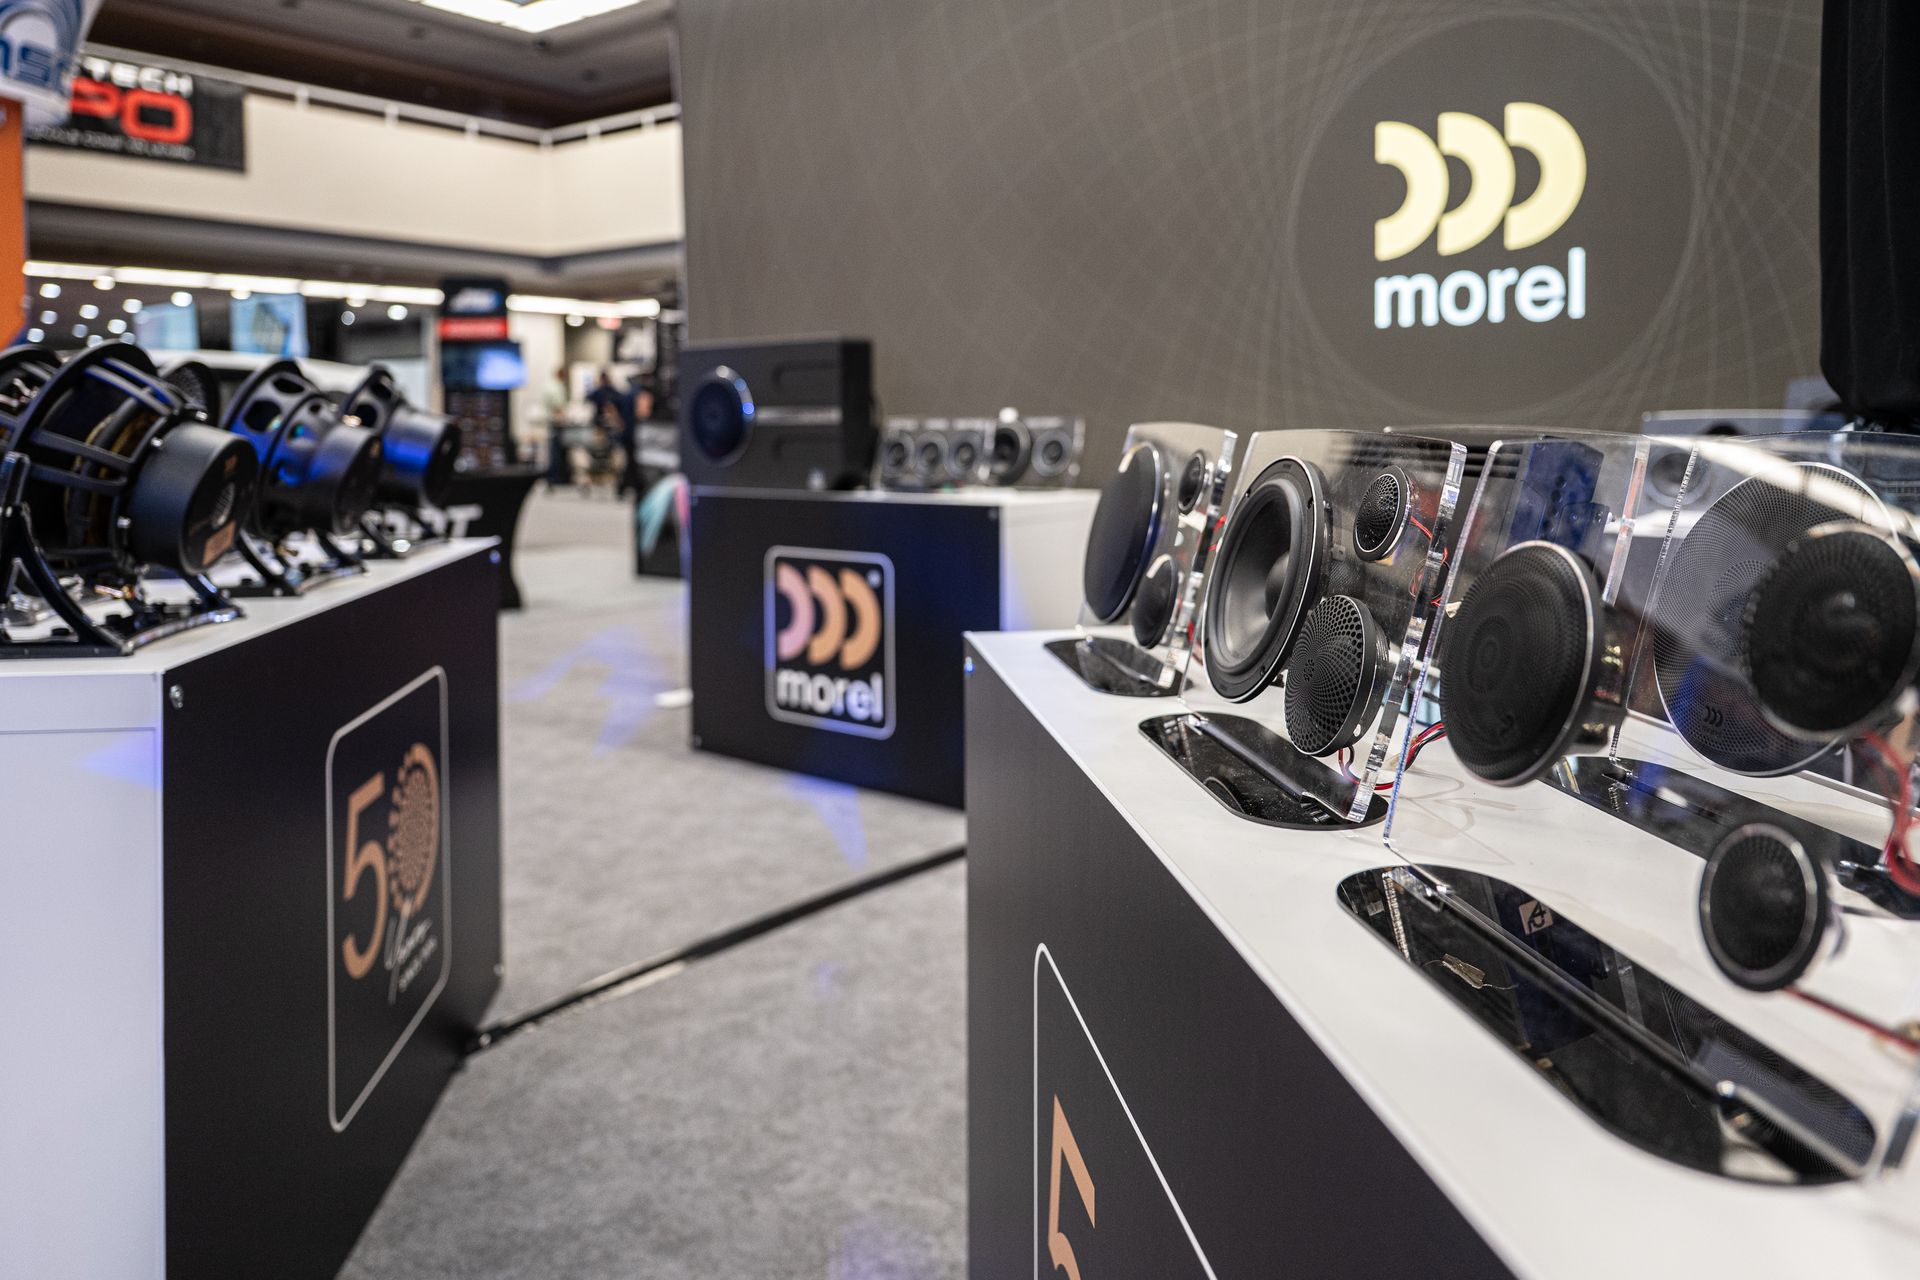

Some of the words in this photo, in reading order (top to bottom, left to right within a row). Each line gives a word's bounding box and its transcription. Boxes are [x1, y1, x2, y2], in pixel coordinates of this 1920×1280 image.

[78, 56, 194, 97] TECH
[70, 77, 193, 144] PO
[1374, 247, 1586, 329] morel
[777, 668, 884, 722] morel
